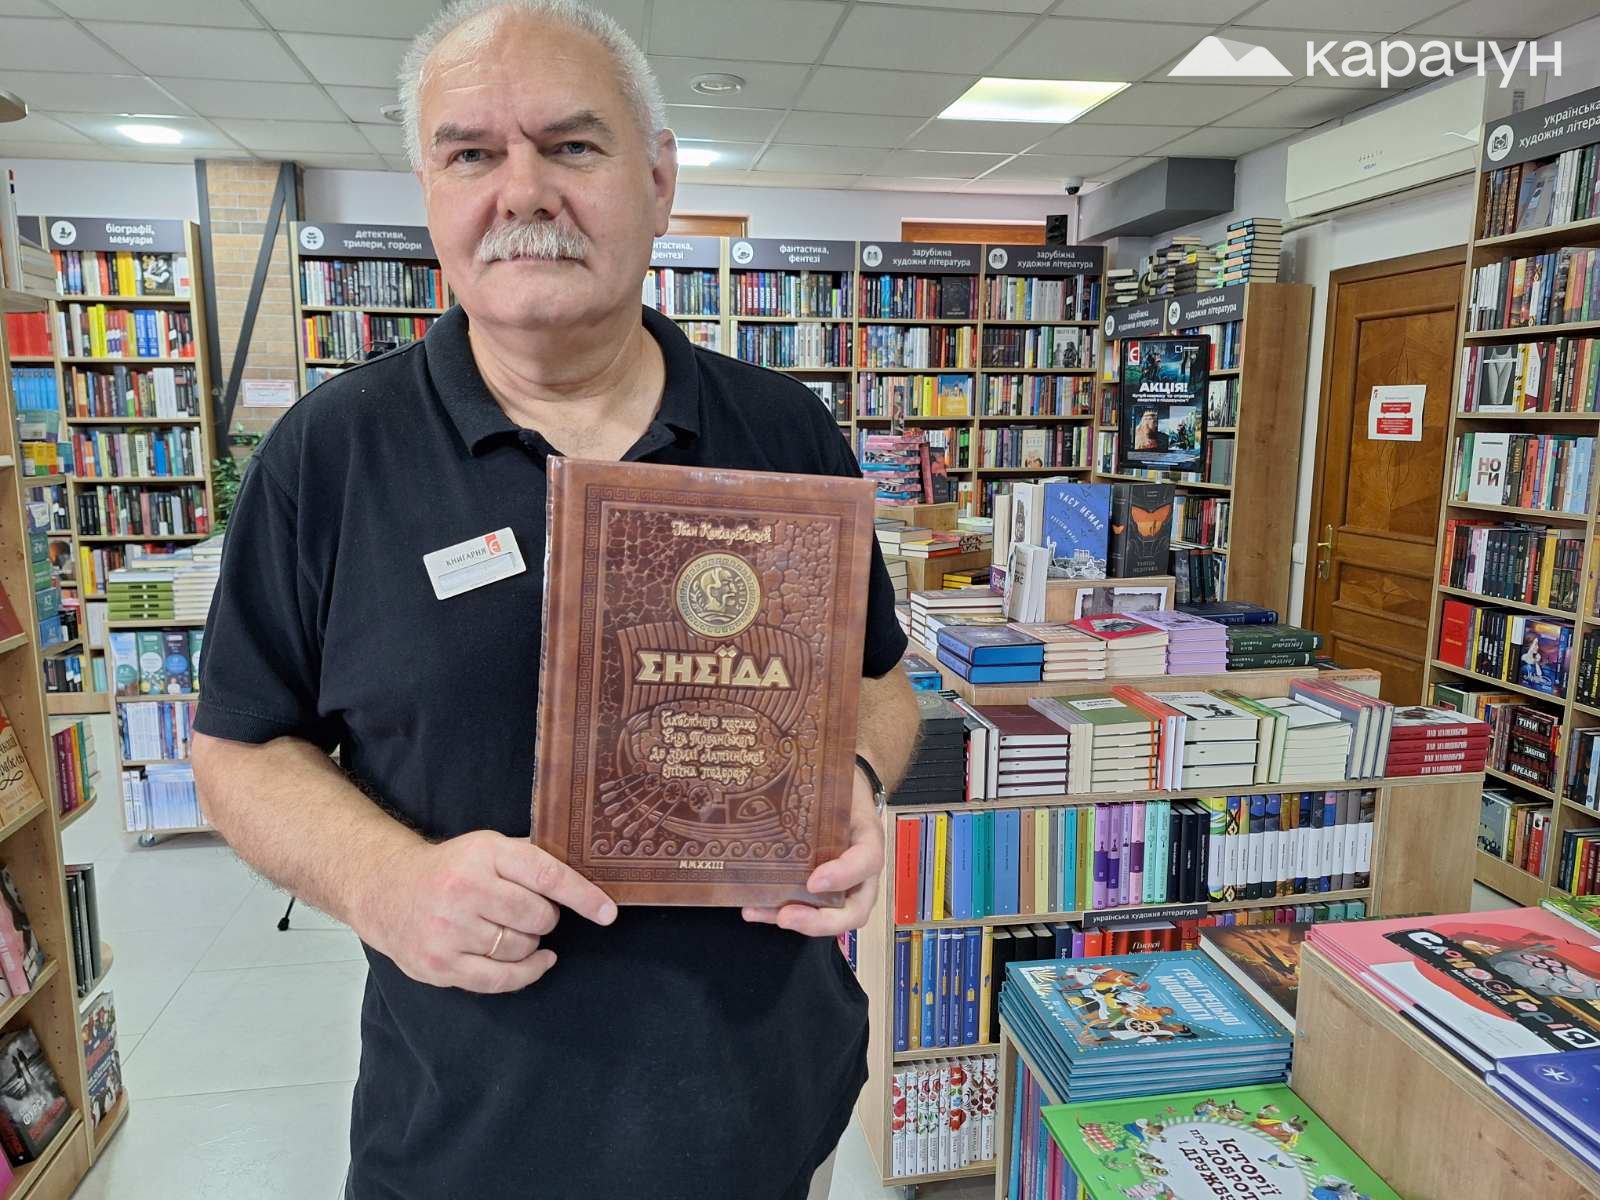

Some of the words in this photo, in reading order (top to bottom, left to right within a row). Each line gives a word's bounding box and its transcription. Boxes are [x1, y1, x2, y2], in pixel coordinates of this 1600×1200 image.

[1519, 127, 1564, 148] художня
[105, 223, 155, 235] біографії,
[109, 235, 153, 246] мемуари
[355, 230, 407, 240] детективи,
[343, 240, 386, 250] трилери,
[388, 242, 422, 251] горори
[653, 241, 693, 251] нтастика,
[779, 244, 829, 255] фантастика,
[912, 247, 952, 258] зарубіжна
[1036, 250, 1075, 260] зарубіжна
[788, 254, 820, 264] фентезі
[892, 257, 927, 267] художня
[928, 258, 972, 268] література
[1017, 259, 1051, 269] художня
[1052, 260, 1094, 270] література
[1207, 303, 1237, 316] література
[1139, 382, 1188, 394] АКЦІЯ!
[1478, 457, 1502, 472] НО
[1477, 472, 1500, 486] ГИ
[446, 548, 487, 566] КНИГАРНЯ
[679, 860, 725, 870] MMXXIII
[1093, 914, 1130, 924] українська
[1131, 911, 1161, 921] художня
[1161, 908, 1199, 918] література
[1172, 968, 1209, 988] ГЕРОЇ
[1192, 989, 1247, 1026] ГРЕЦЬКОЇ
[1217, 1138, 1282, 1196] ІСТОРІЇ
